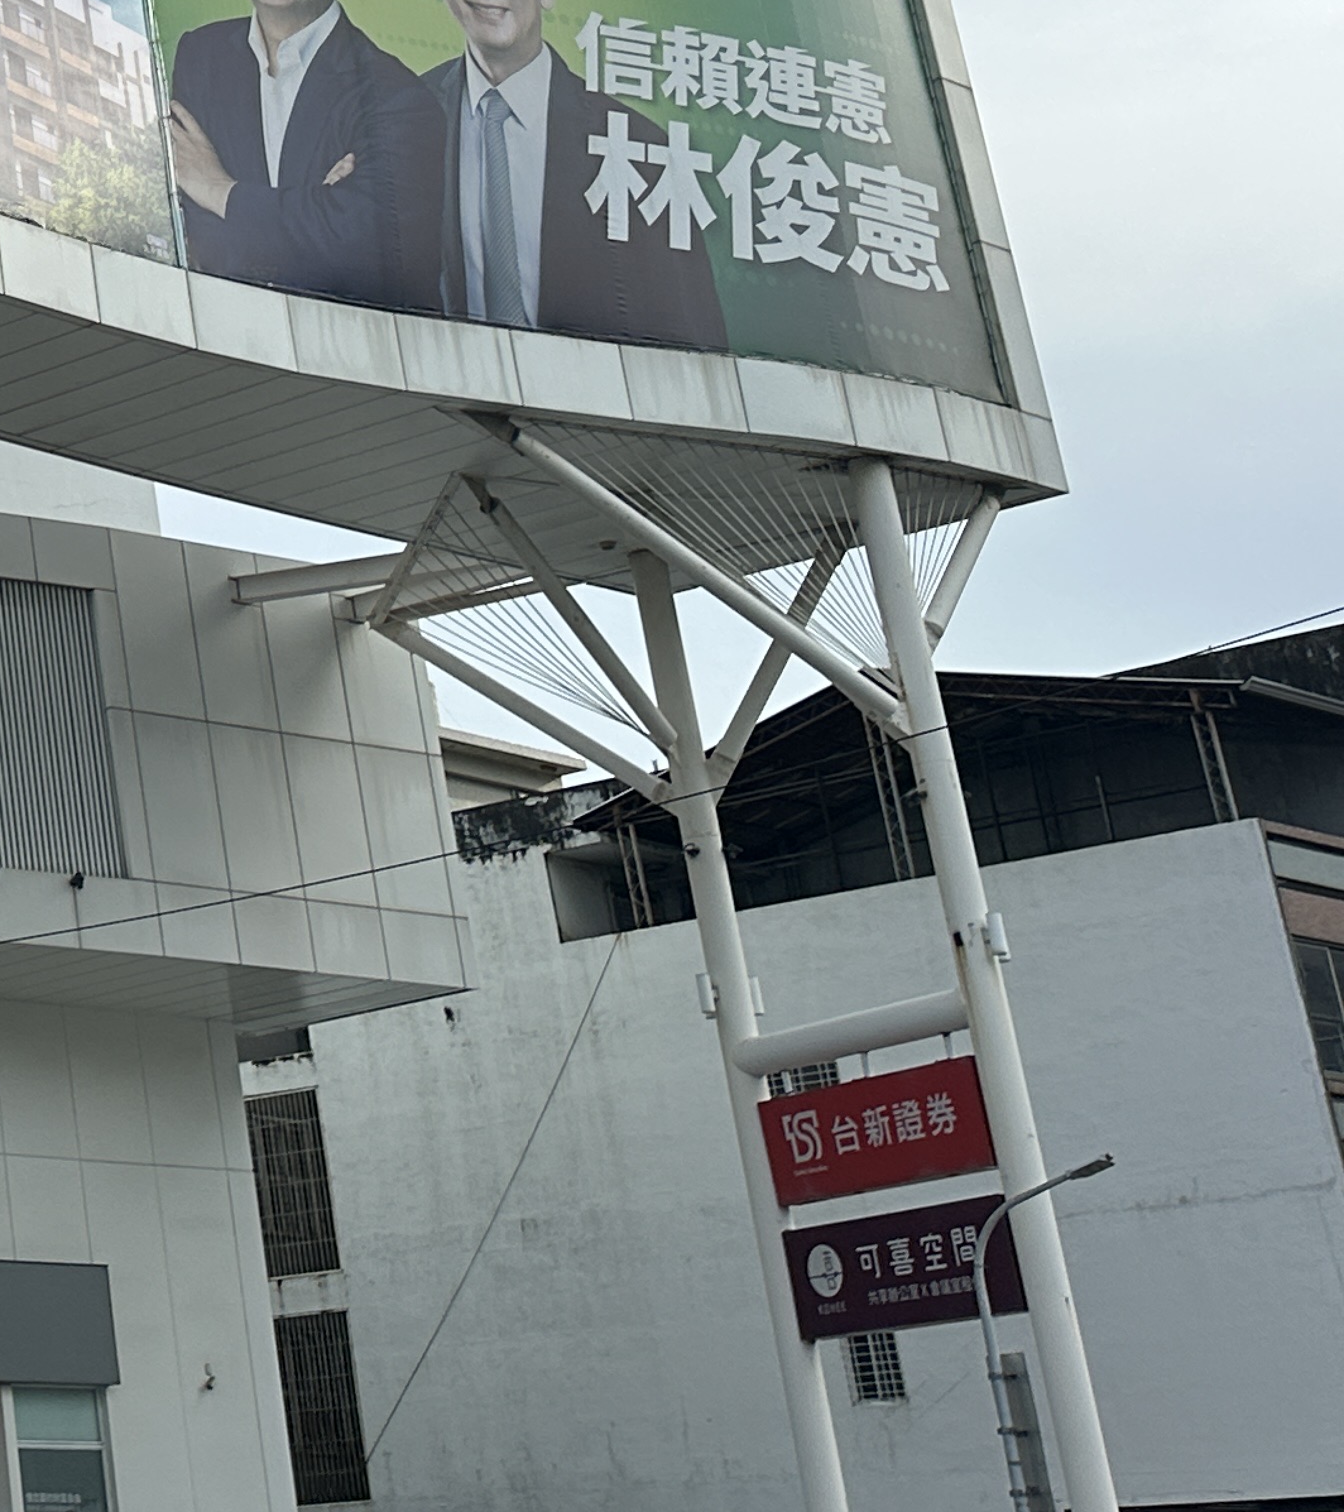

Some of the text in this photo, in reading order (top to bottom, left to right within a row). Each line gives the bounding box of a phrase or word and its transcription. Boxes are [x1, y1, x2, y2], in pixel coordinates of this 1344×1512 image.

[574, 11, 895, 146] 信賴連憲
[584, 111, 952, 294] 林俊憲
[830, 1091, 958, 1156] 台新證券
[855, 1225, 978, 1279] 可喜空間
